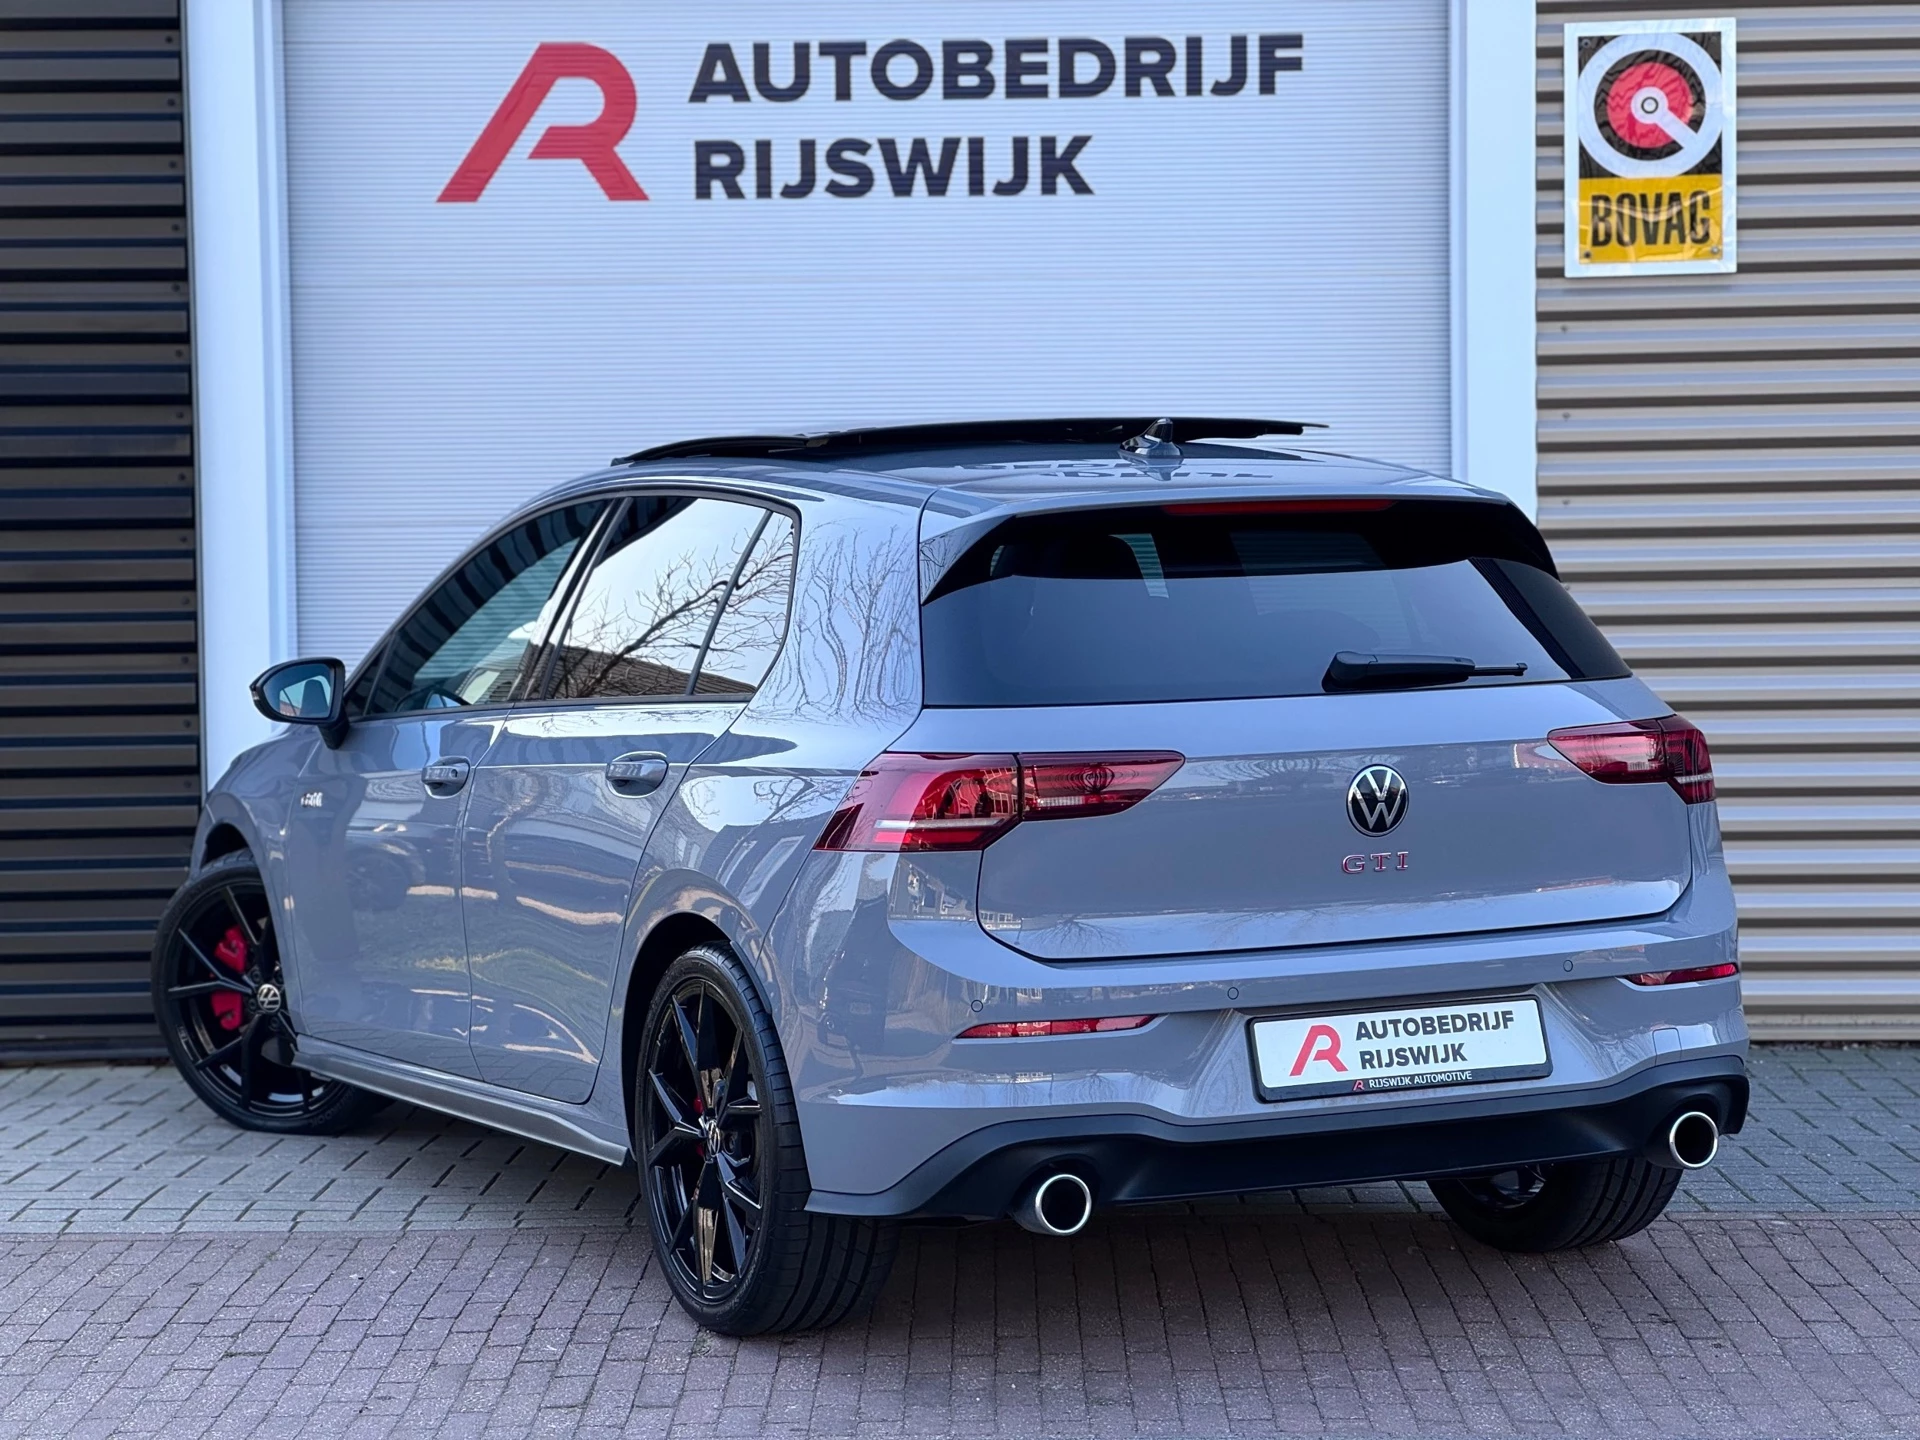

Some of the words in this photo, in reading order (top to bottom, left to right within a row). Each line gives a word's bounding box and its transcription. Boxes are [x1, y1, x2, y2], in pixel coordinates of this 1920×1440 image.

[688, 34, 1304, 103] AUTOBEDRIJF
[694, 135, 1094, 200] RIJSWIJK
[1591, 190, 1711, 248] BOVAG
[1342, 851, 1409, 873] GTI
[1355, 1010, 1515, 1042] AUTOBEDRIJF
[1359, 1042, 1468, 1070] RIJSWIJK
[1368, 1076, 1412, 1088] RIJSWIJK
[1414, 1070, 1473, 1084] AUTOMOTIVE
